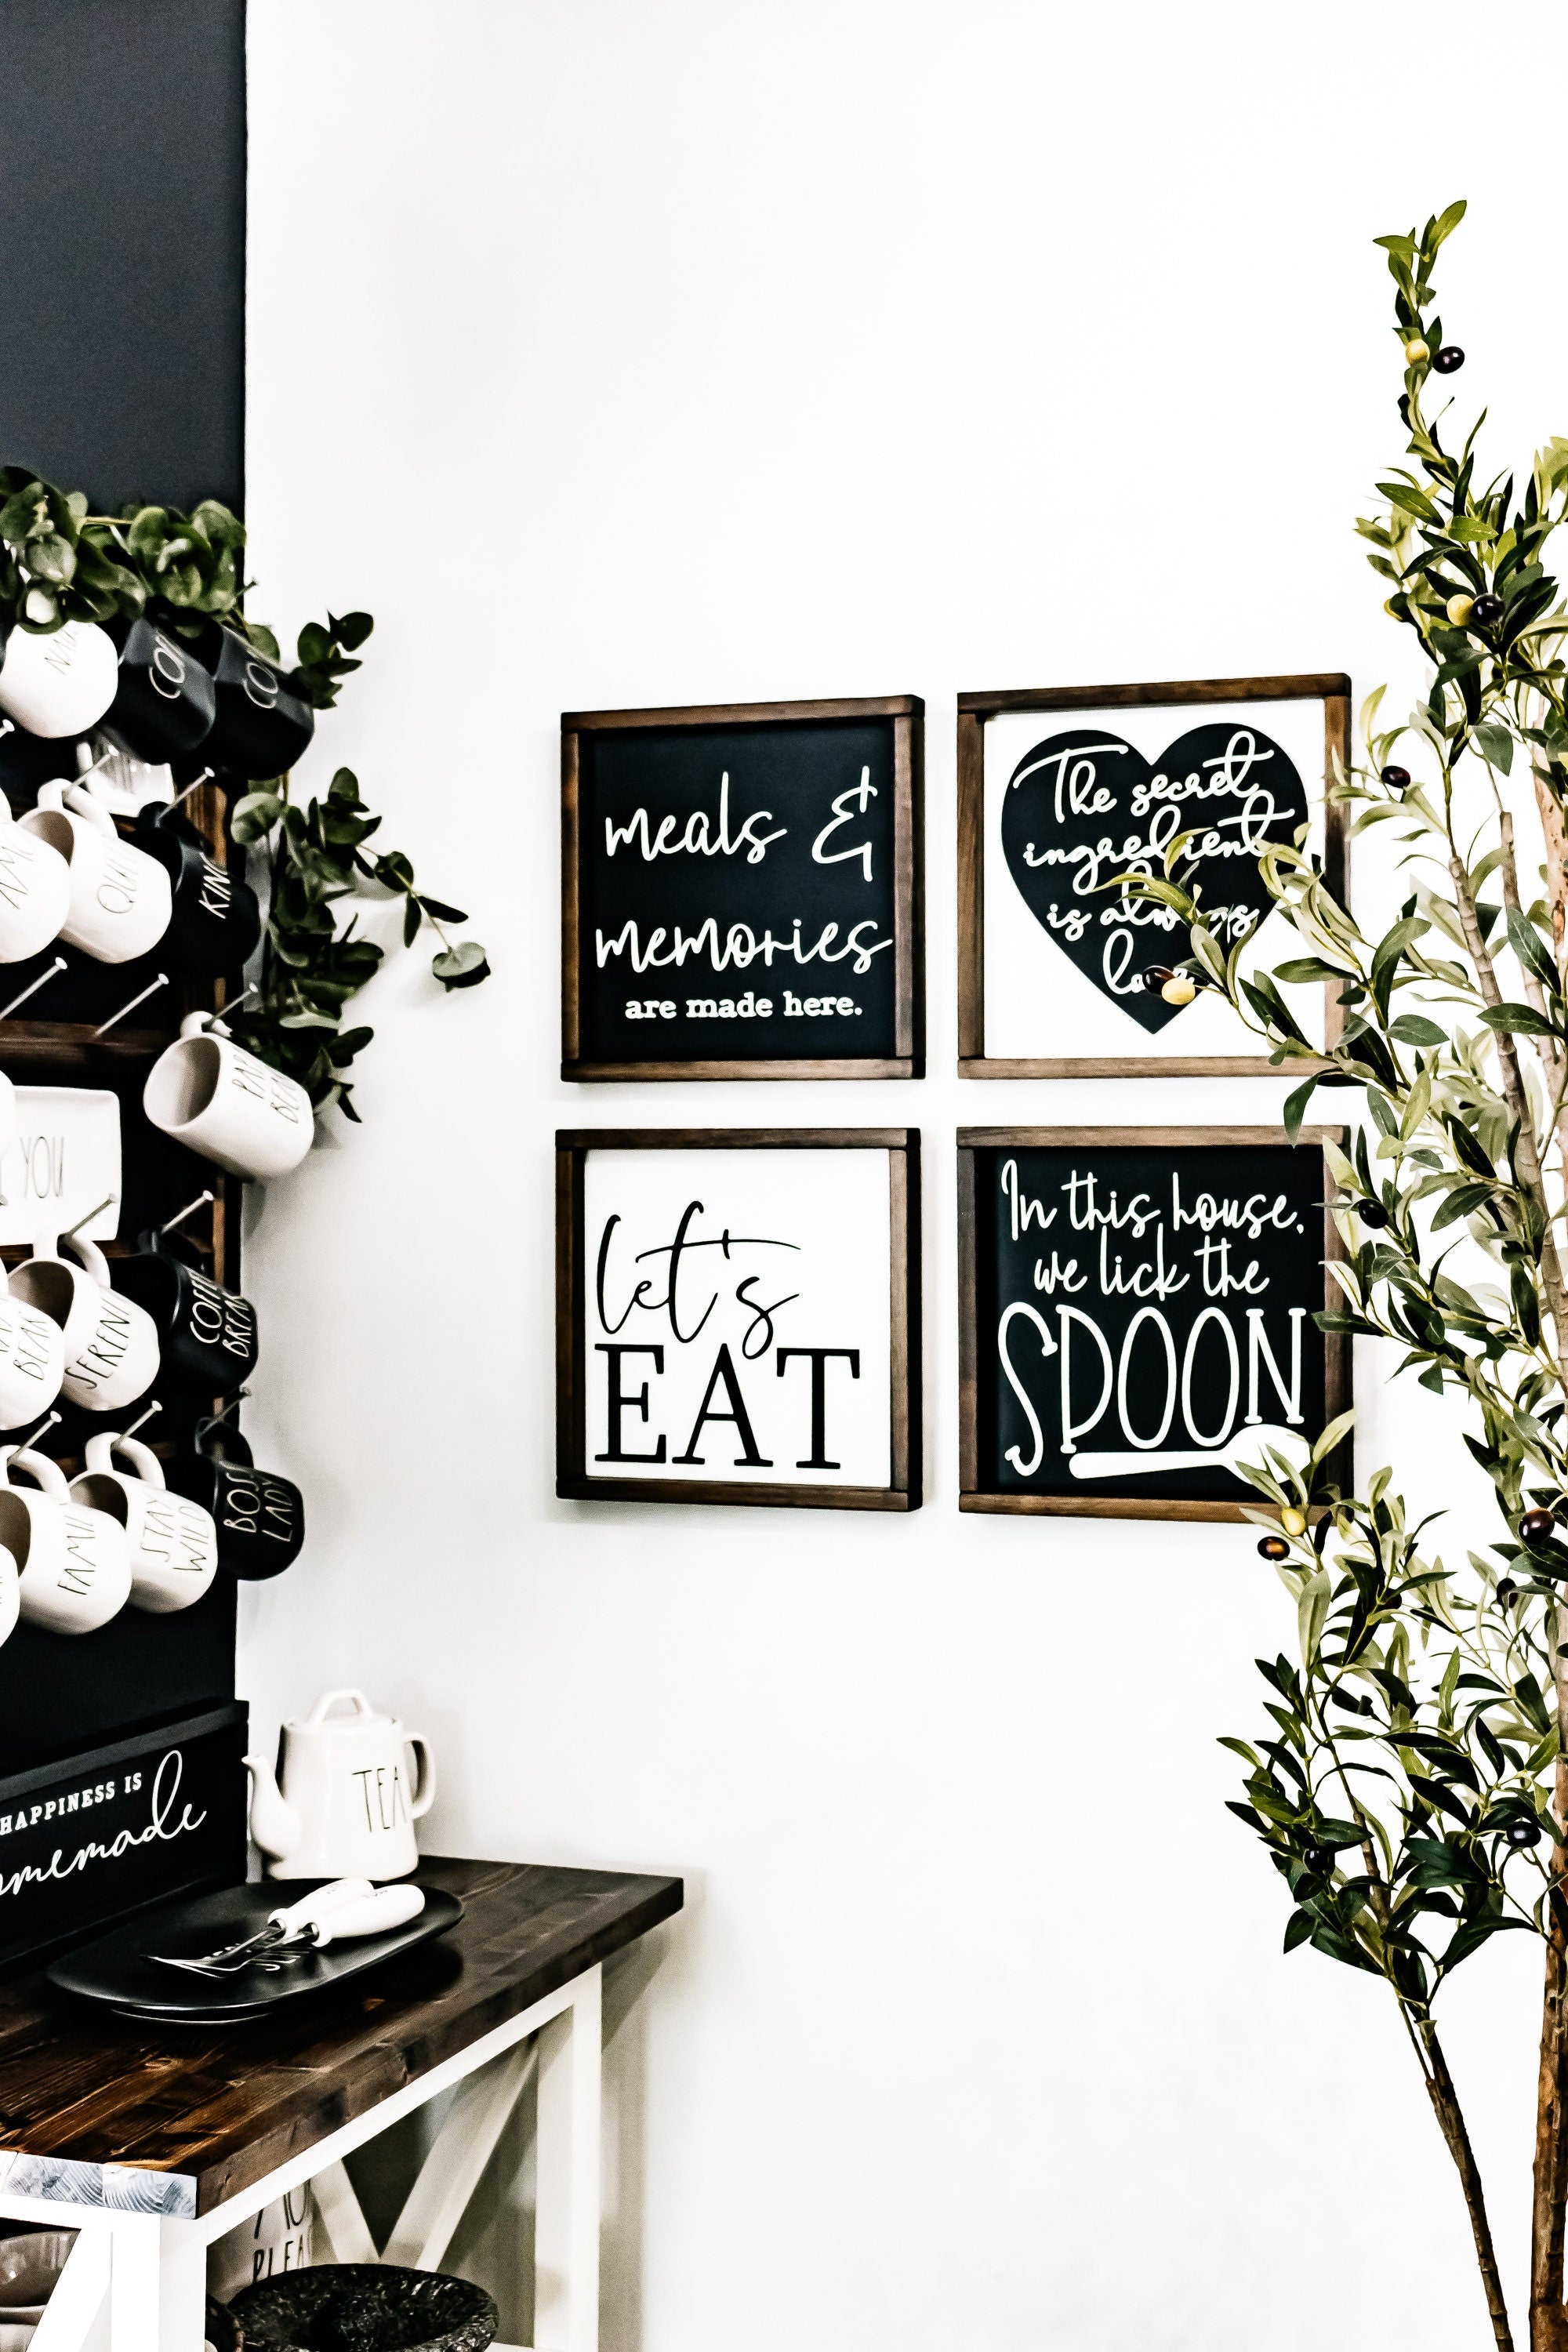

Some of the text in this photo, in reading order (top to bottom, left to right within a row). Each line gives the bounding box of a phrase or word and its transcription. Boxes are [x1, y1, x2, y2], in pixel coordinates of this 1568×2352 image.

[1013, 731, 1275, 823] The secret
[606, 766, 878, 882] meals &
[596, 918, 894, 975] memories
[1047, 903, 1092, 942] is
[625, 991, 862, 1019] are made here.
[20, 1136, 64, 1200] YOU
[1001, 1160, 1057, 1241] In
[1061, 1170, 1161, 1238] this
[597, 1201, 801, 1359] let's
[1033, 1223, 1270, 1301] we lick the
[595, 1343, 860, 1469] EAT
[998, 1301, 1306, 1476] SPOON
[0, 1772, 143, 1835] HAPPINESS IS
[352, 1765, 407, 1833] TEA
